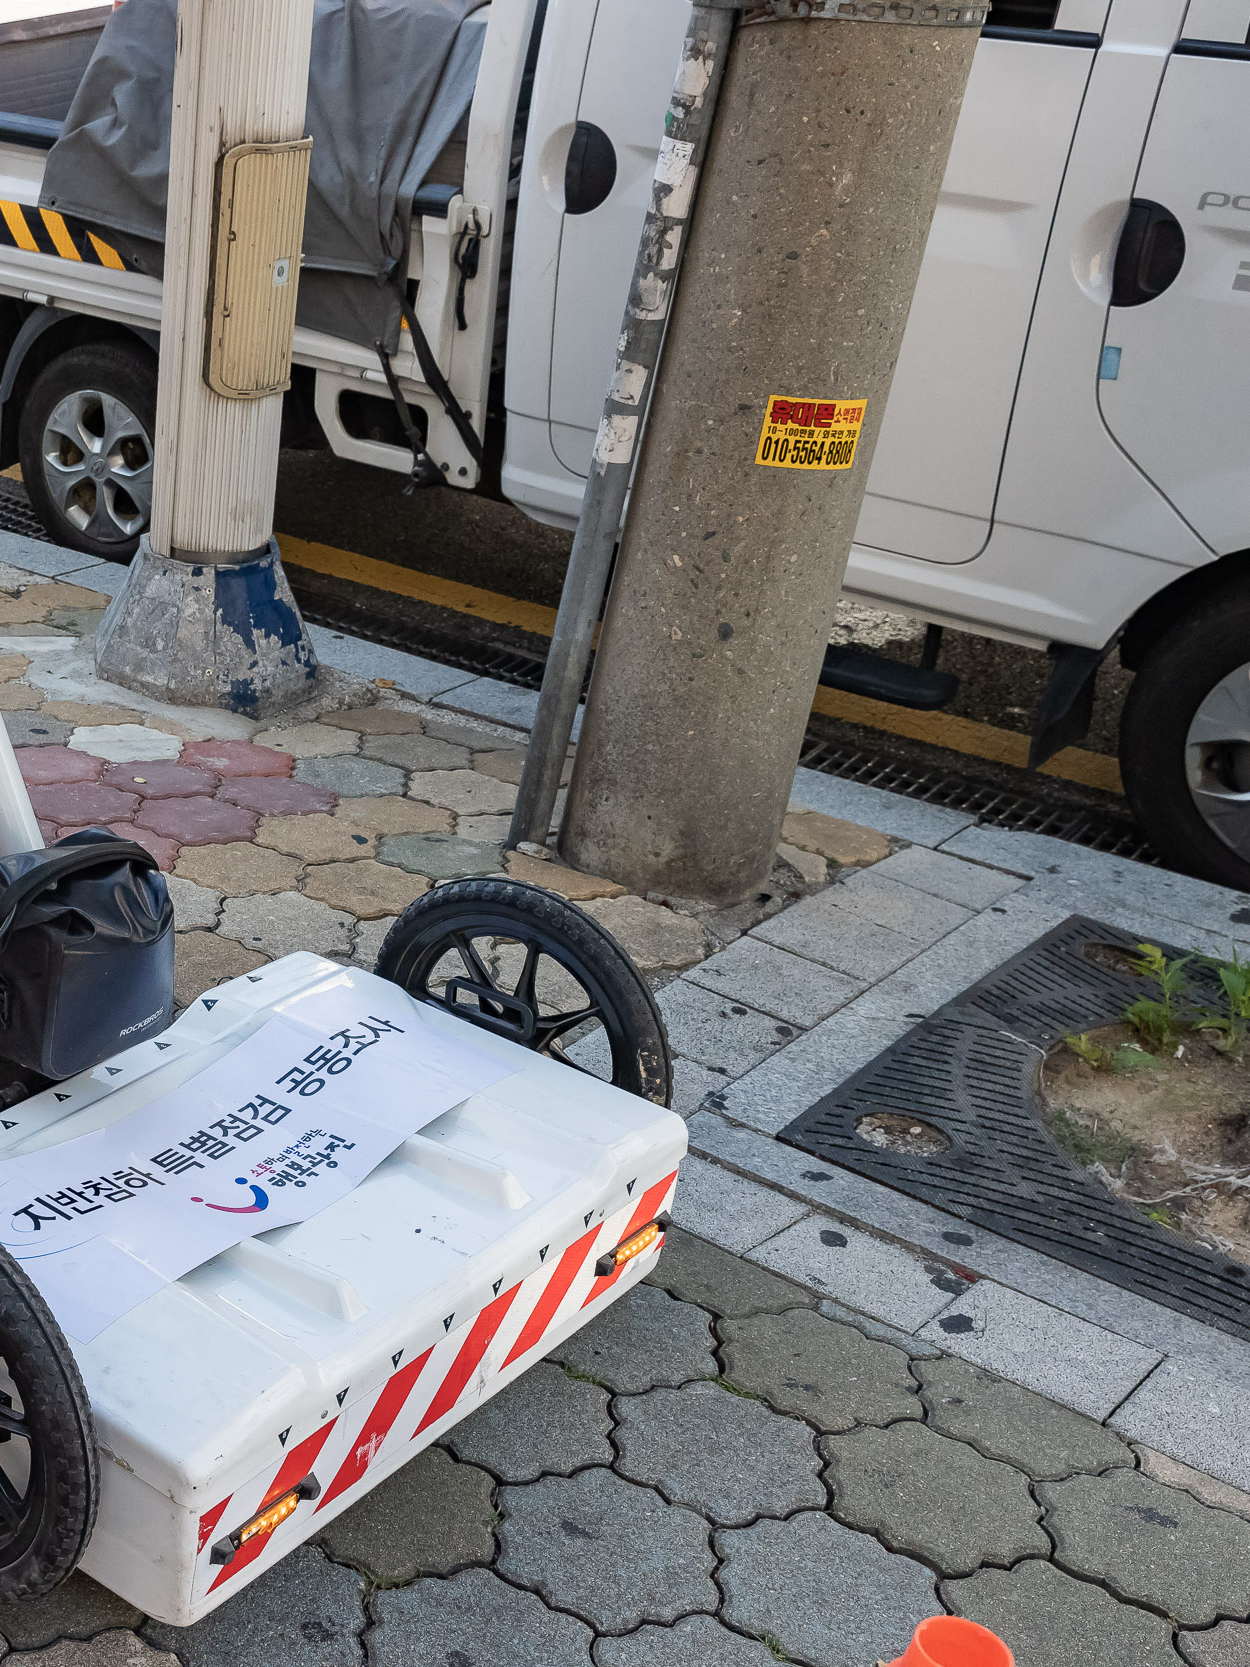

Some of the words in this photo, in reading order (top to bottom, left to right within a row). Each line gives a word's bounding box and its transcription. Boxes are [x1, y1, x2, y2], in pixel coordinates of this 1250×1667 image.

[770, 400, 836, 428] 휴대폰
[119, 1006, 164, 1038] ROCKBROS
[12, 1166, 166, 1231] 지반침하
[150, 1094, 293, 1175] 특별점검
[275, 1016, 405, 1096] 공동조사
[267, 1134, 356, 1187] 행복광진
